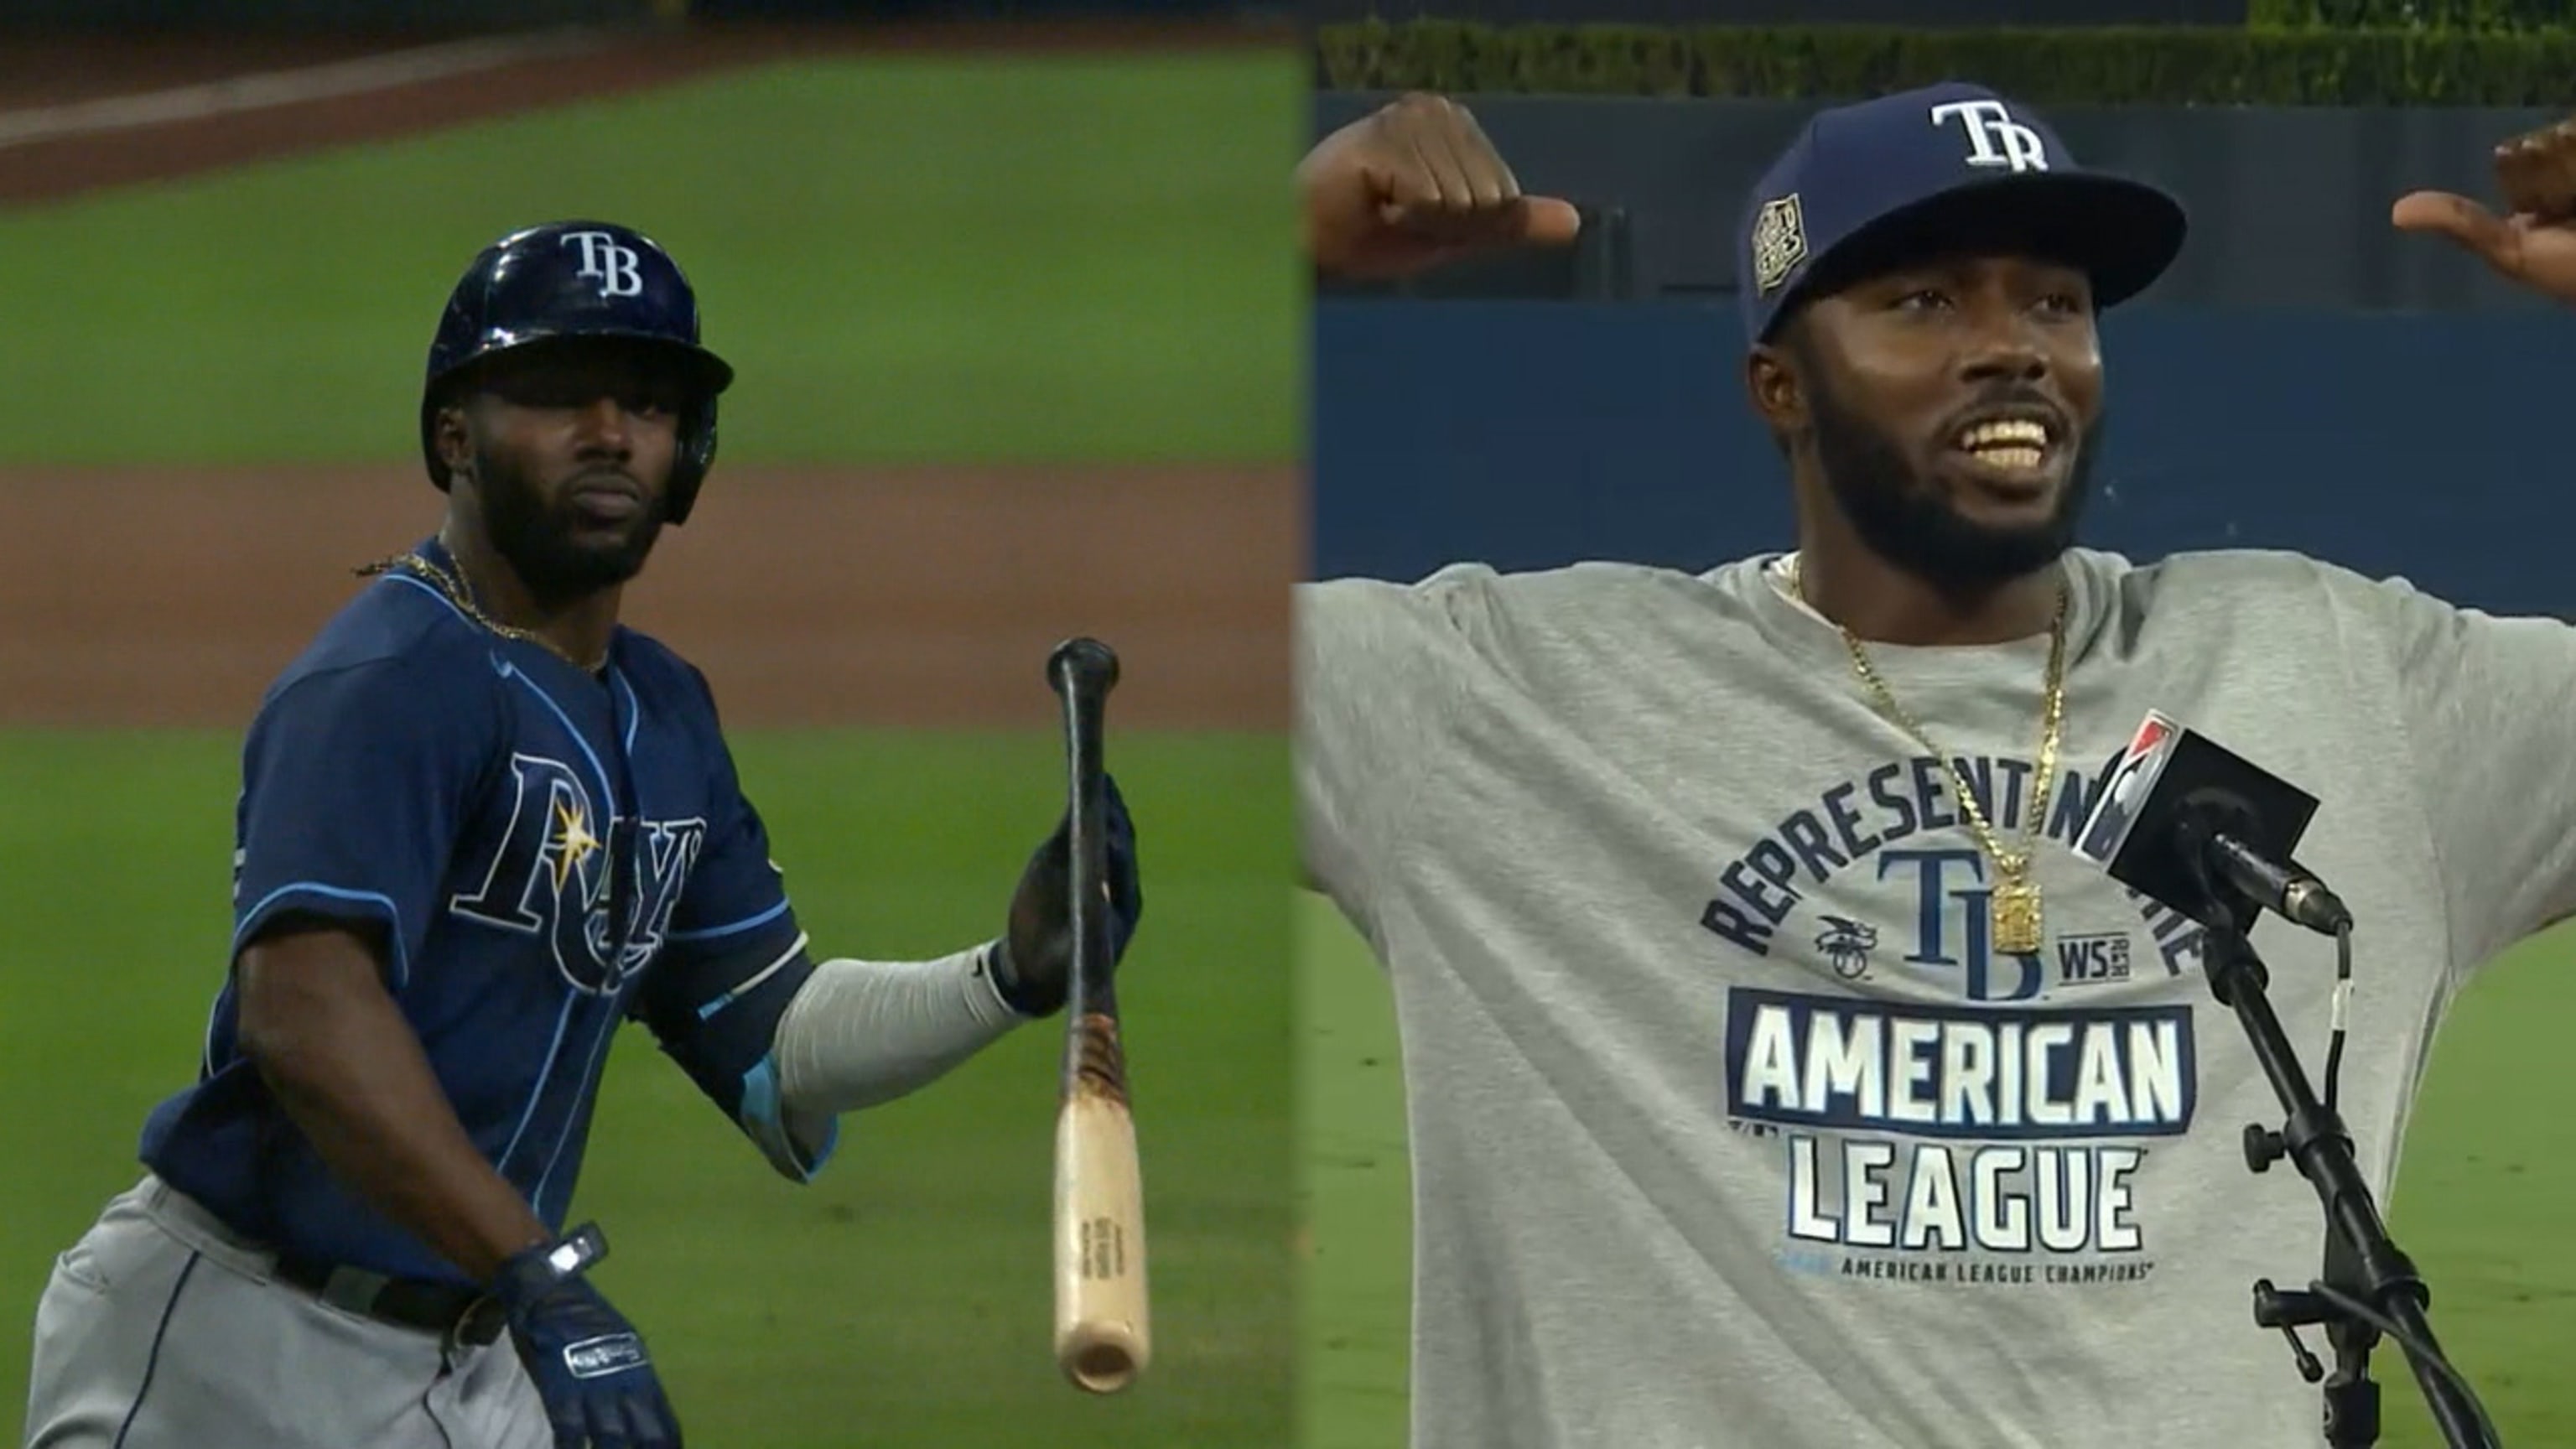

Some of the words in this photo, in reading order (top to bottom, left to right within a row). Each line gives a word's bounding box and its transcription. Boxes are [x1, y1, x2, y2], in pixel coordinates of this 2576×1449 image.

[559, 231, 642, 297] TB
[1700, 756, 2100, 956] REPRESENTN
[2058, 940, 2108, 979] WS
[1741, 1005, 2182, 1124] AMERICAN
[1788, 1135, 2143, 1253] LEAGUE
[1841, 1258, 1947, 1281] AMERICAN
[1957, 1263, 2033, 1284] LEAGUE
